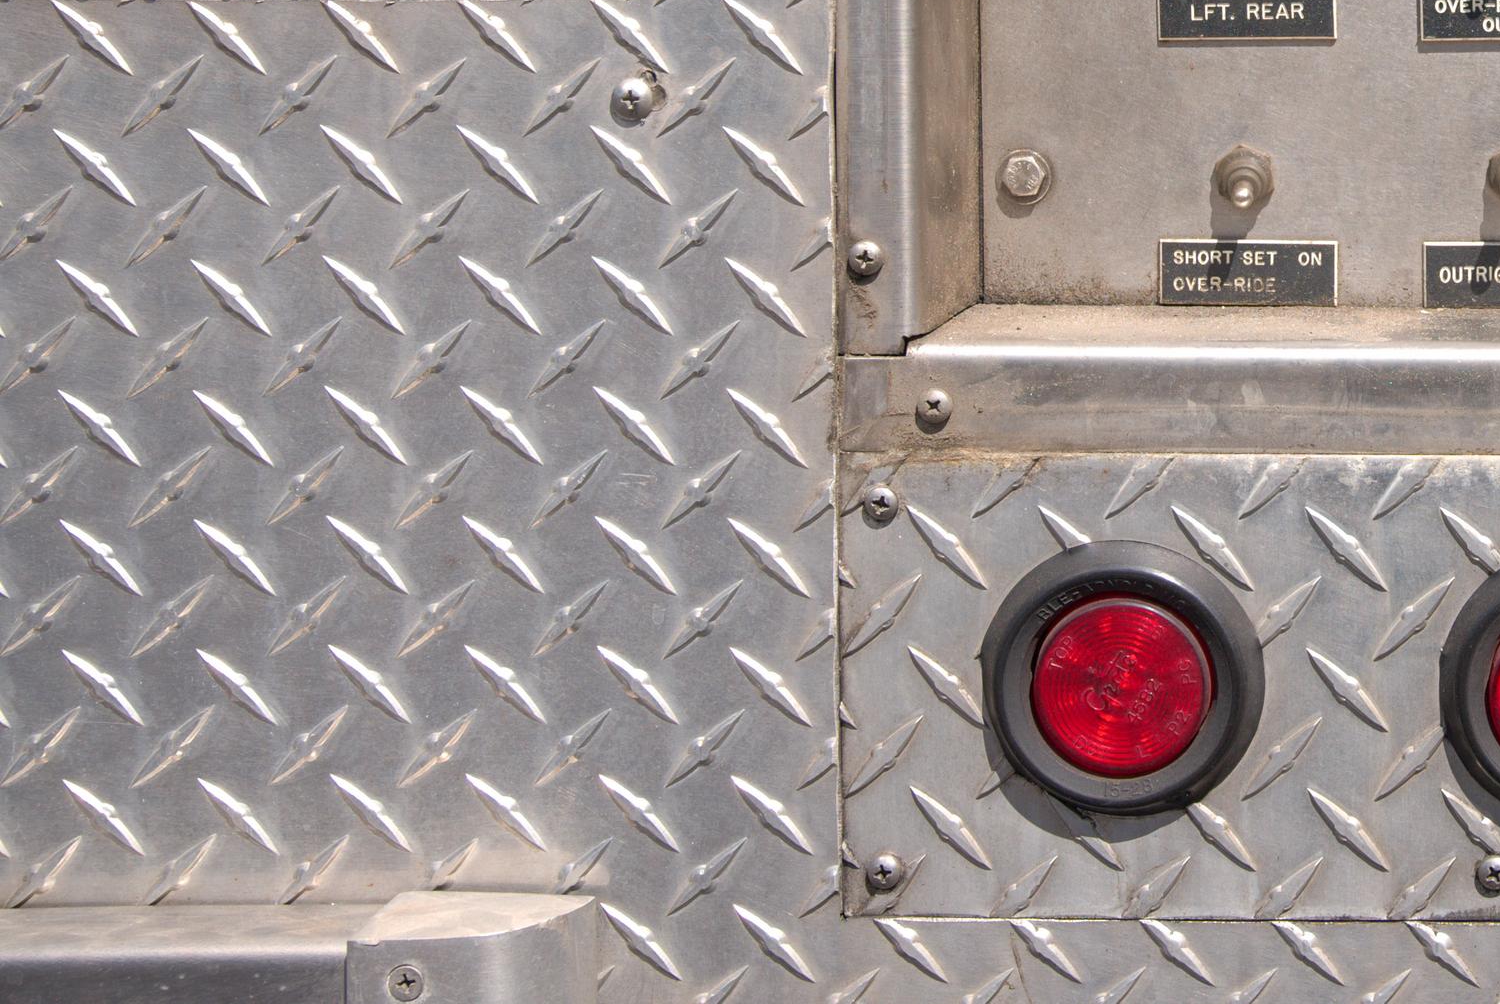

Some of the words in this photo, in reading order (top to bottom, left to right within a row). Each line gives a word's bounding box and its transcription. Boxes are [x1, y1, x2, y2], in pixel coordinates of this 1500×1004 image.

[1190, 3, 1235, 21] LFT.
[1246, 2, 1305, 20] REAR
[1173, 250, 1234, 265] SHORT
[1242, 251, 1278, 265] SET
[1298, 251, 1323, 266] ON
[1173, 276, 1276, 293] OVER-RIDE
[1048, 635, 1073, 669] TOP
